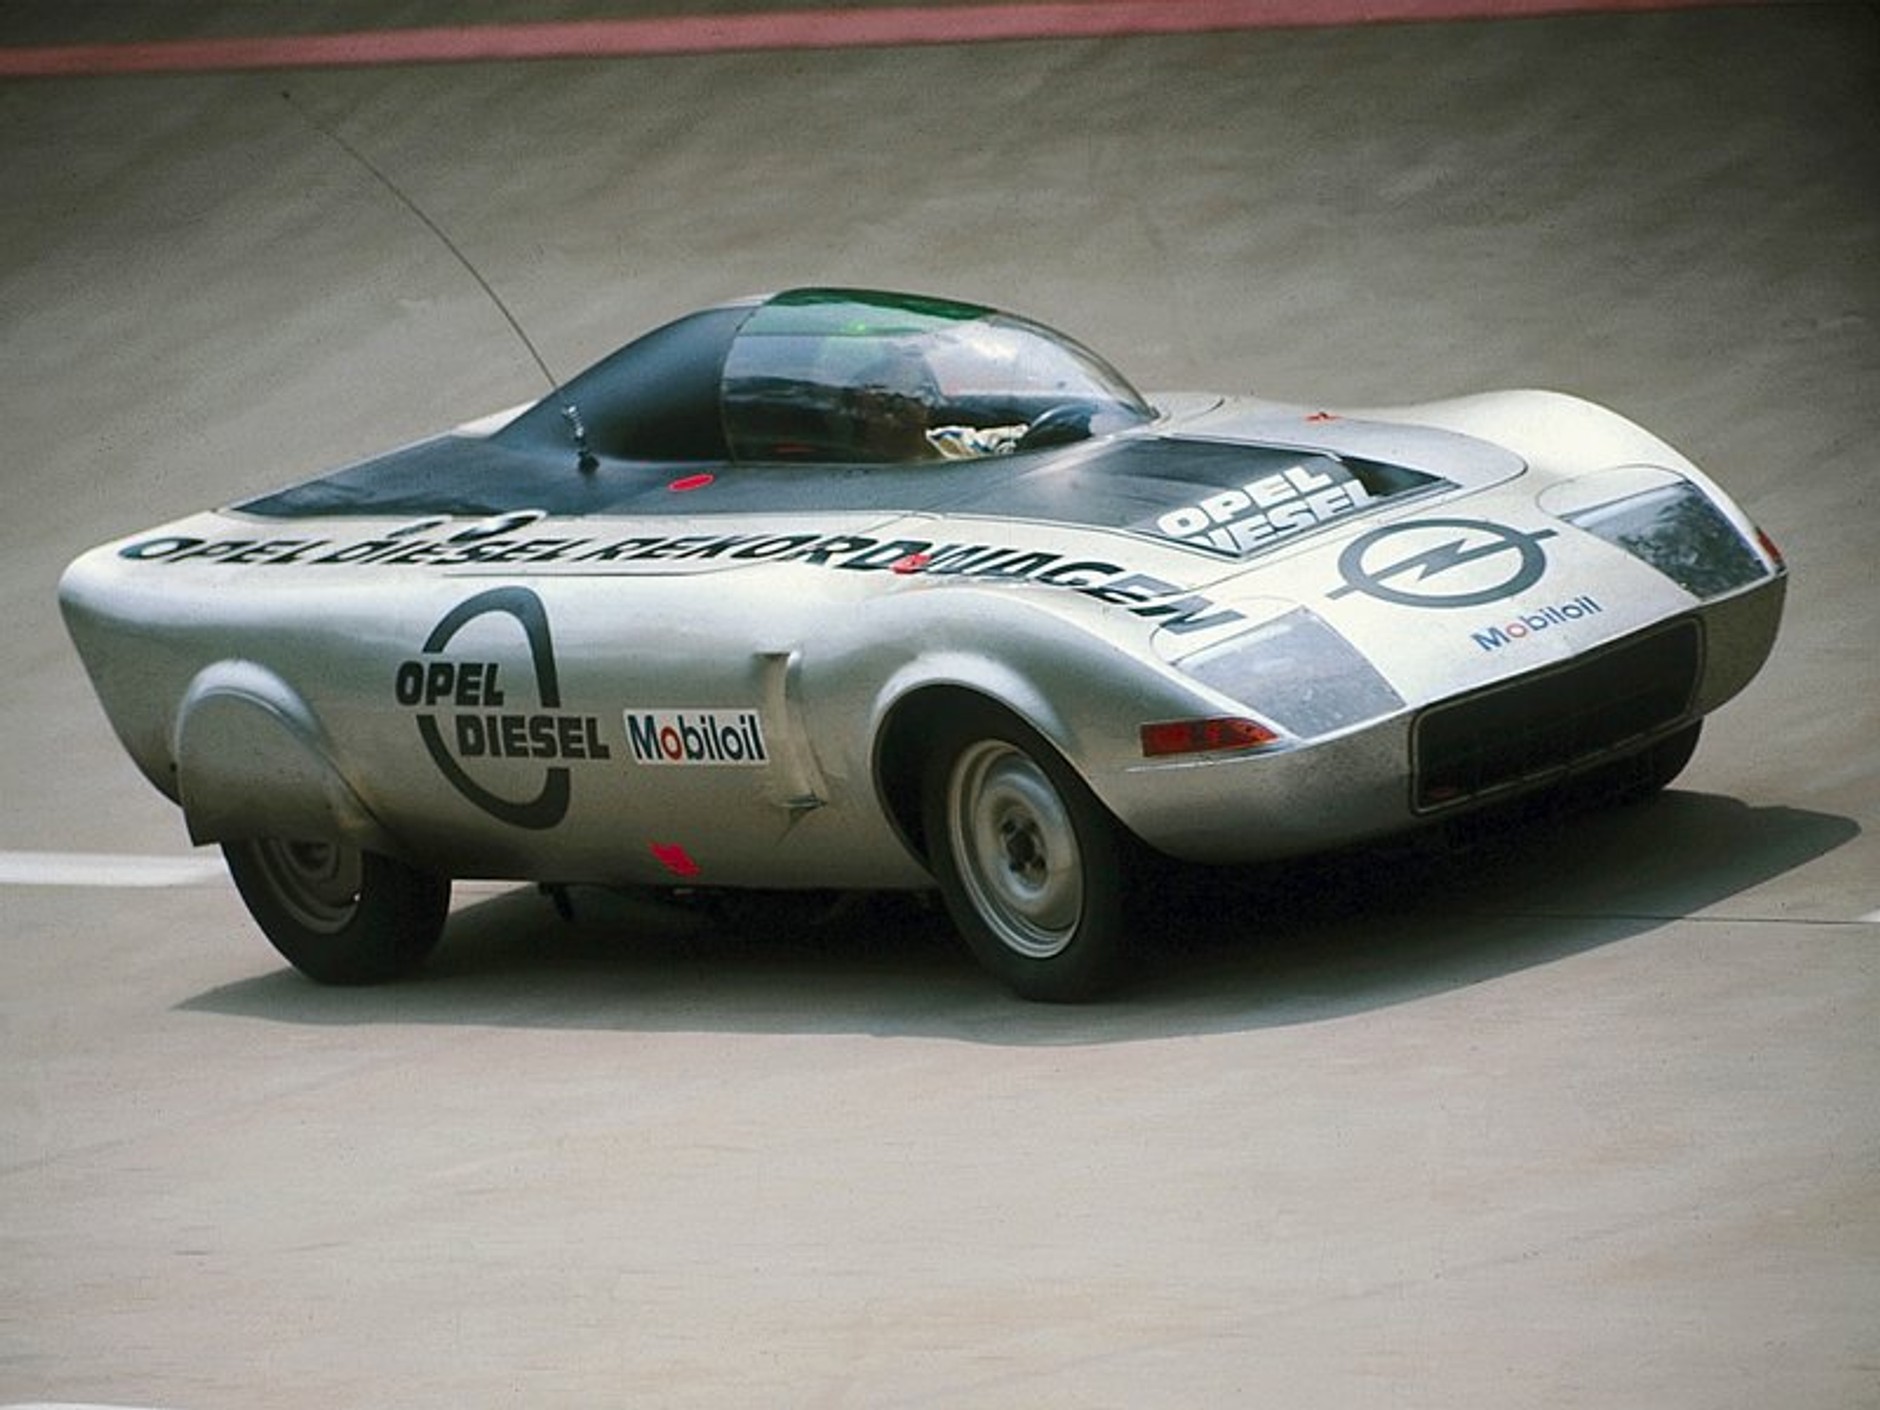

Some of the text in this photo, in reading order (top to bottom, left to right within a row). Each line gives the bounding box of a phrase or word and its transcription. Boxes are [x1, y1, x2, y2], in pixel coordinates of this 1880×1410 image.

[1157, 465, 1333, 538] OPEL
[118, 537, 331, 564] OPEL
[1471, 595, 1602, 652] Mobiloil
[396, 663, 504, 706] OPEL
[456, 715, 611, 761] DIESEL
[627, 713, 767, 762] Mobiloil
